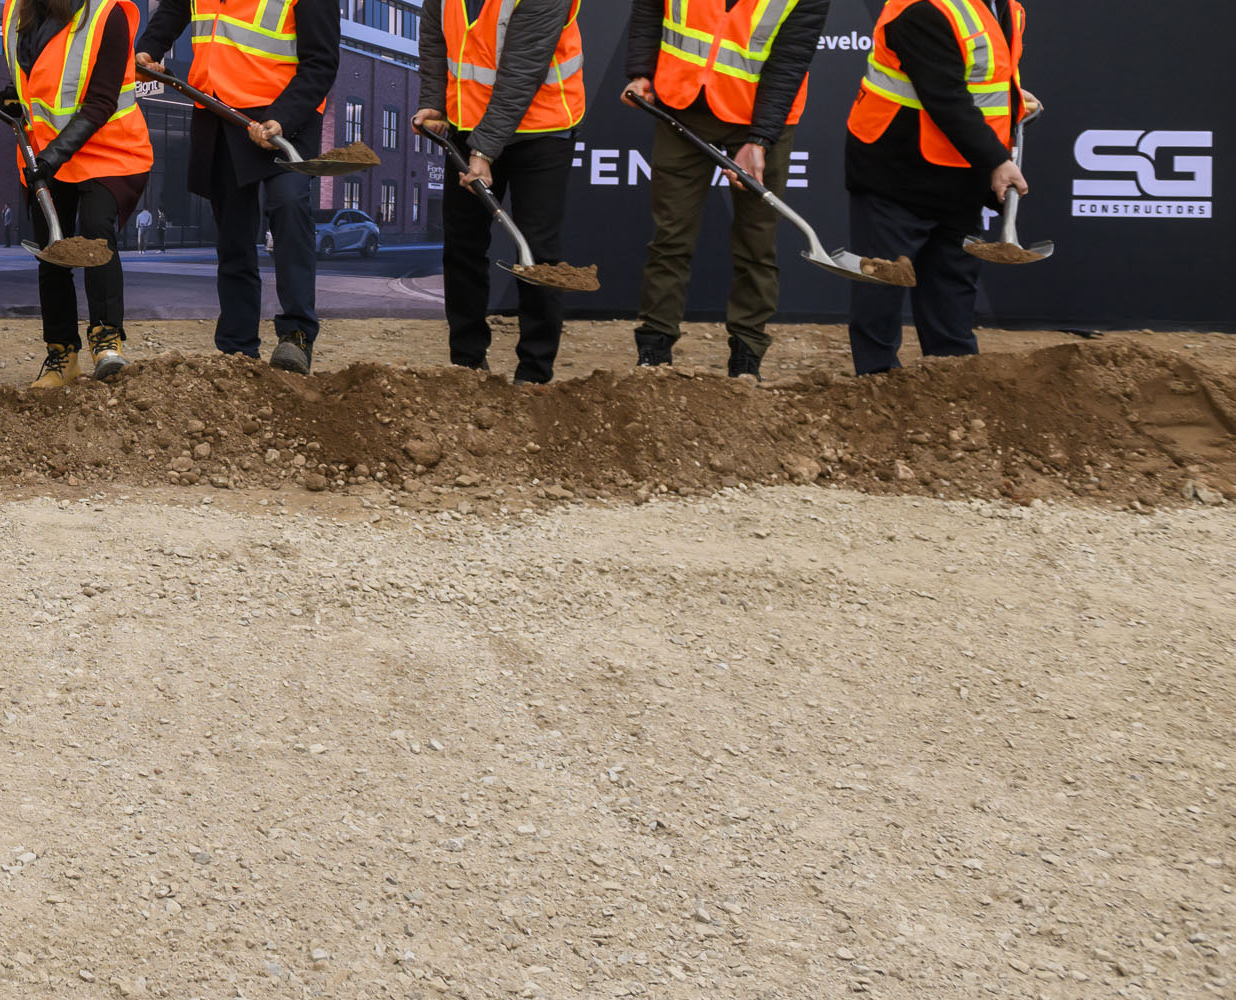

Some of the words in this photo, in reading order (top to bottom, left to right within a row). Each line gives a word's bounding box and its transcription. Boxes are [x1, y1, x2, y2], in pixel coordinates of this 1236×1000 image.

[816, 31, 875, 50] evelo
[1073, 130, 1213, 197] SG
[1079, 203, 1206, 215] CONSTRUCTORS
